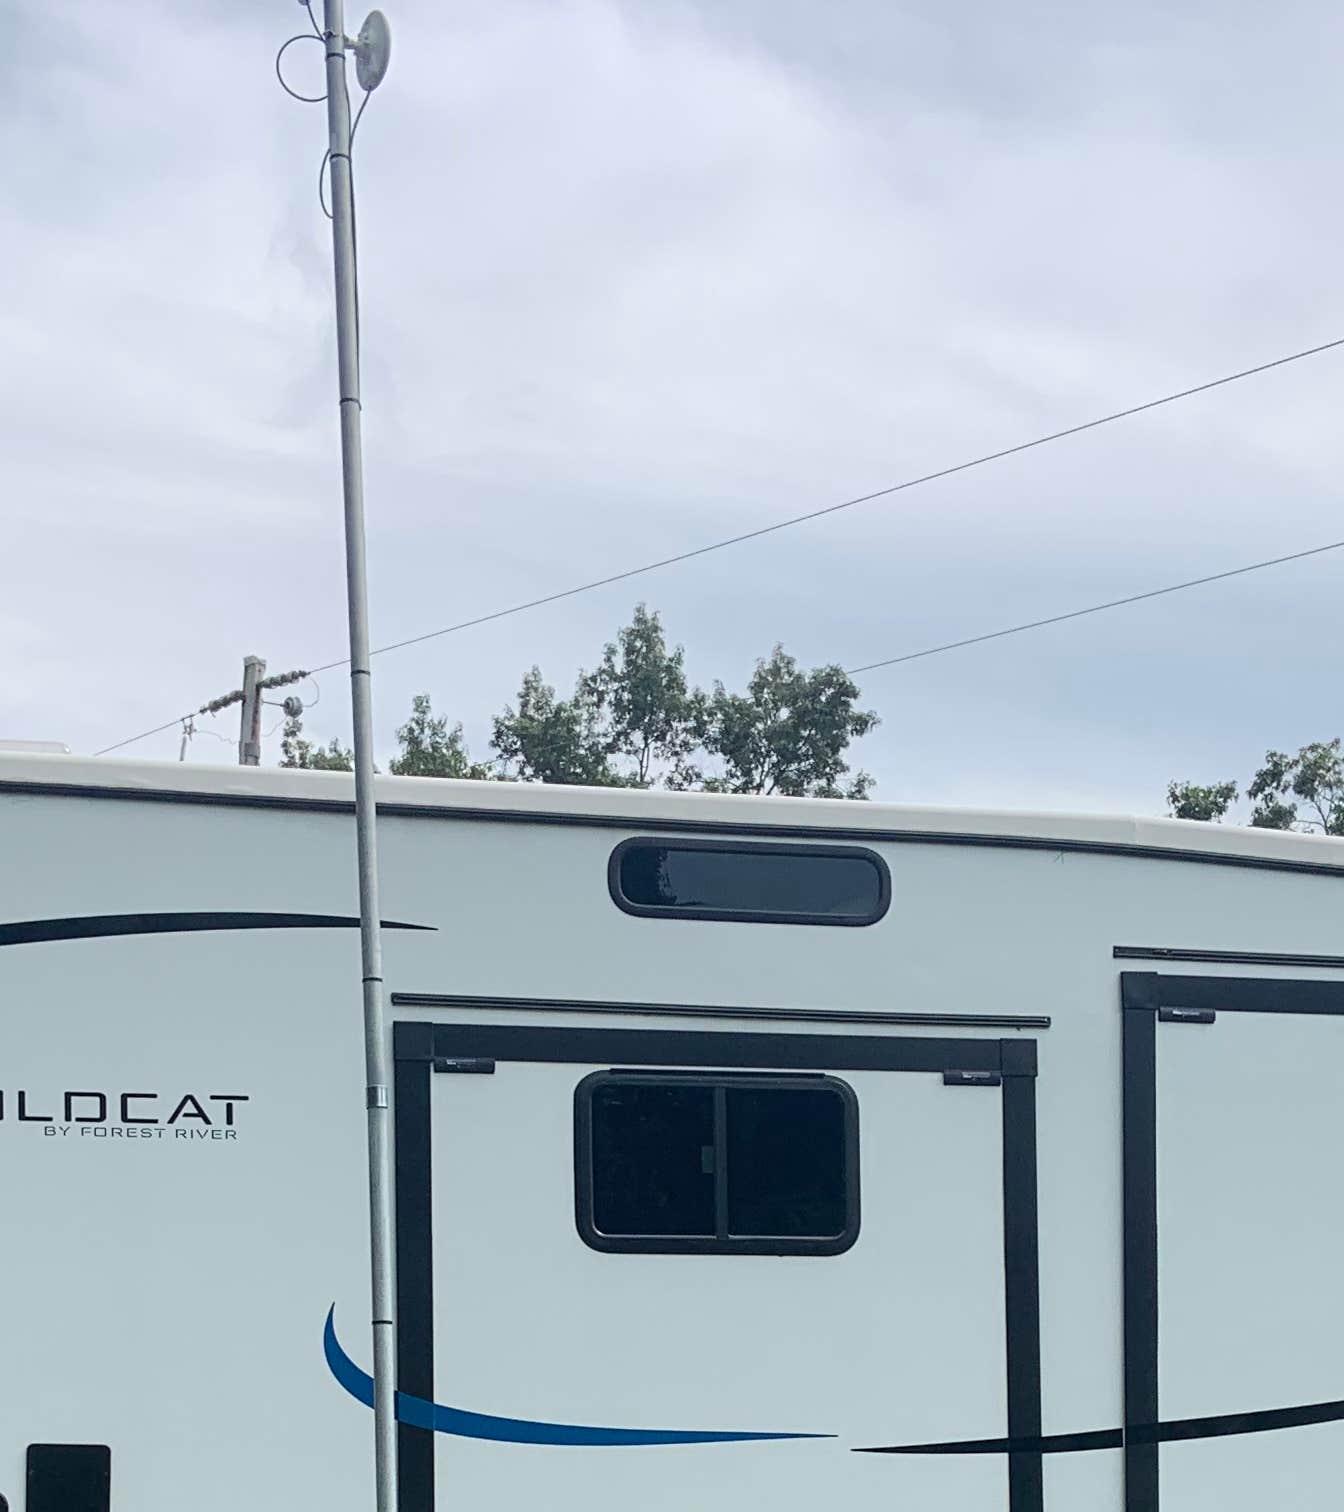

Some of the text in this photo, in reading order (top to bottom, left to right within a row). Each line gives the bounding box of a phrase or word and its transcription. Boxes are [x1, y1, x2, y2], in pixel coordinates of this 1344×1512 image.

[44, 1126, 238, 1140] BY FOREST RIVER
